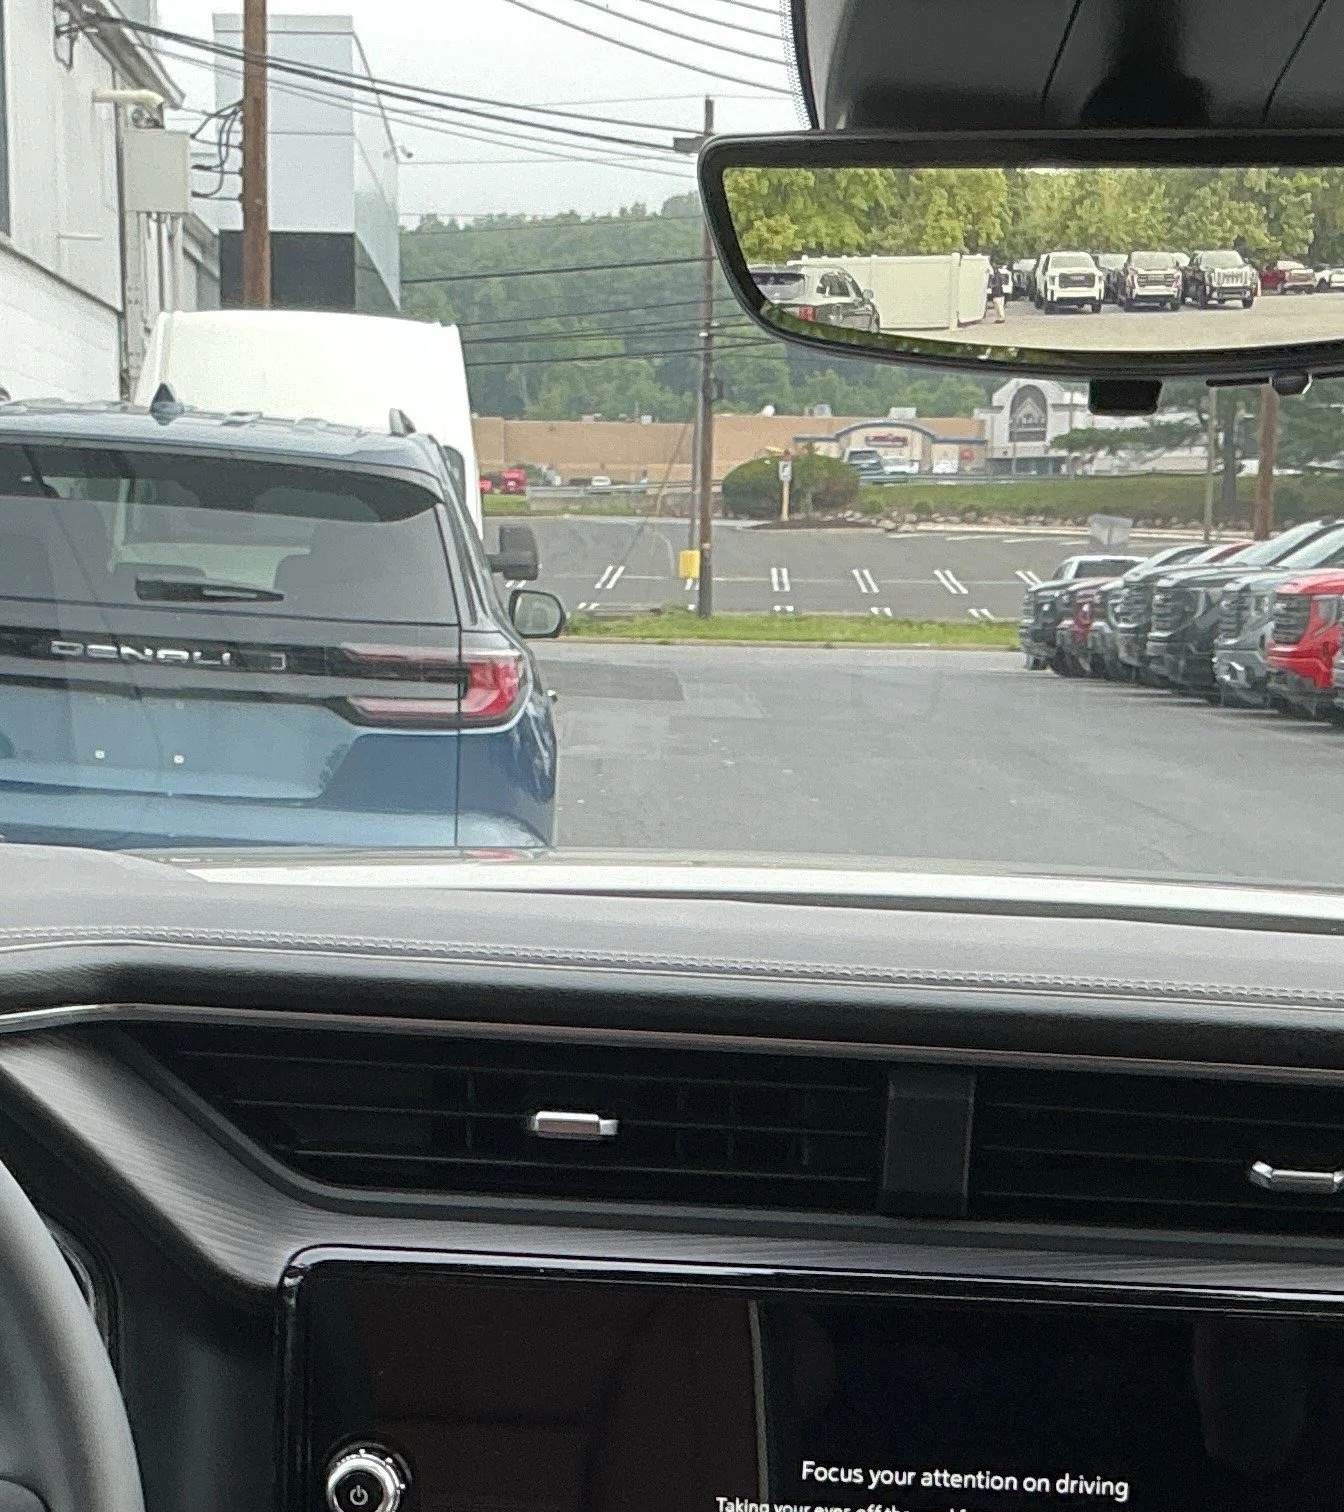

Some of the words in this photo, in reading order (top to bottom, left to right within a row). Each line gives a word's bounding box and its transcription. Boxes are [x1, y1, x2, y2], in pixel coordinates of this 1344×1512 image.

[51, 641, 231, 666] DENALI
[801, 1460, 864, 1484] Focus
[868, 1469, 916, 1490] your
[920, 1468, 1018, 1491] attention
[1023, 1477, 1050, 1493] on
[1056, 1473, 1129, 1502] driving
